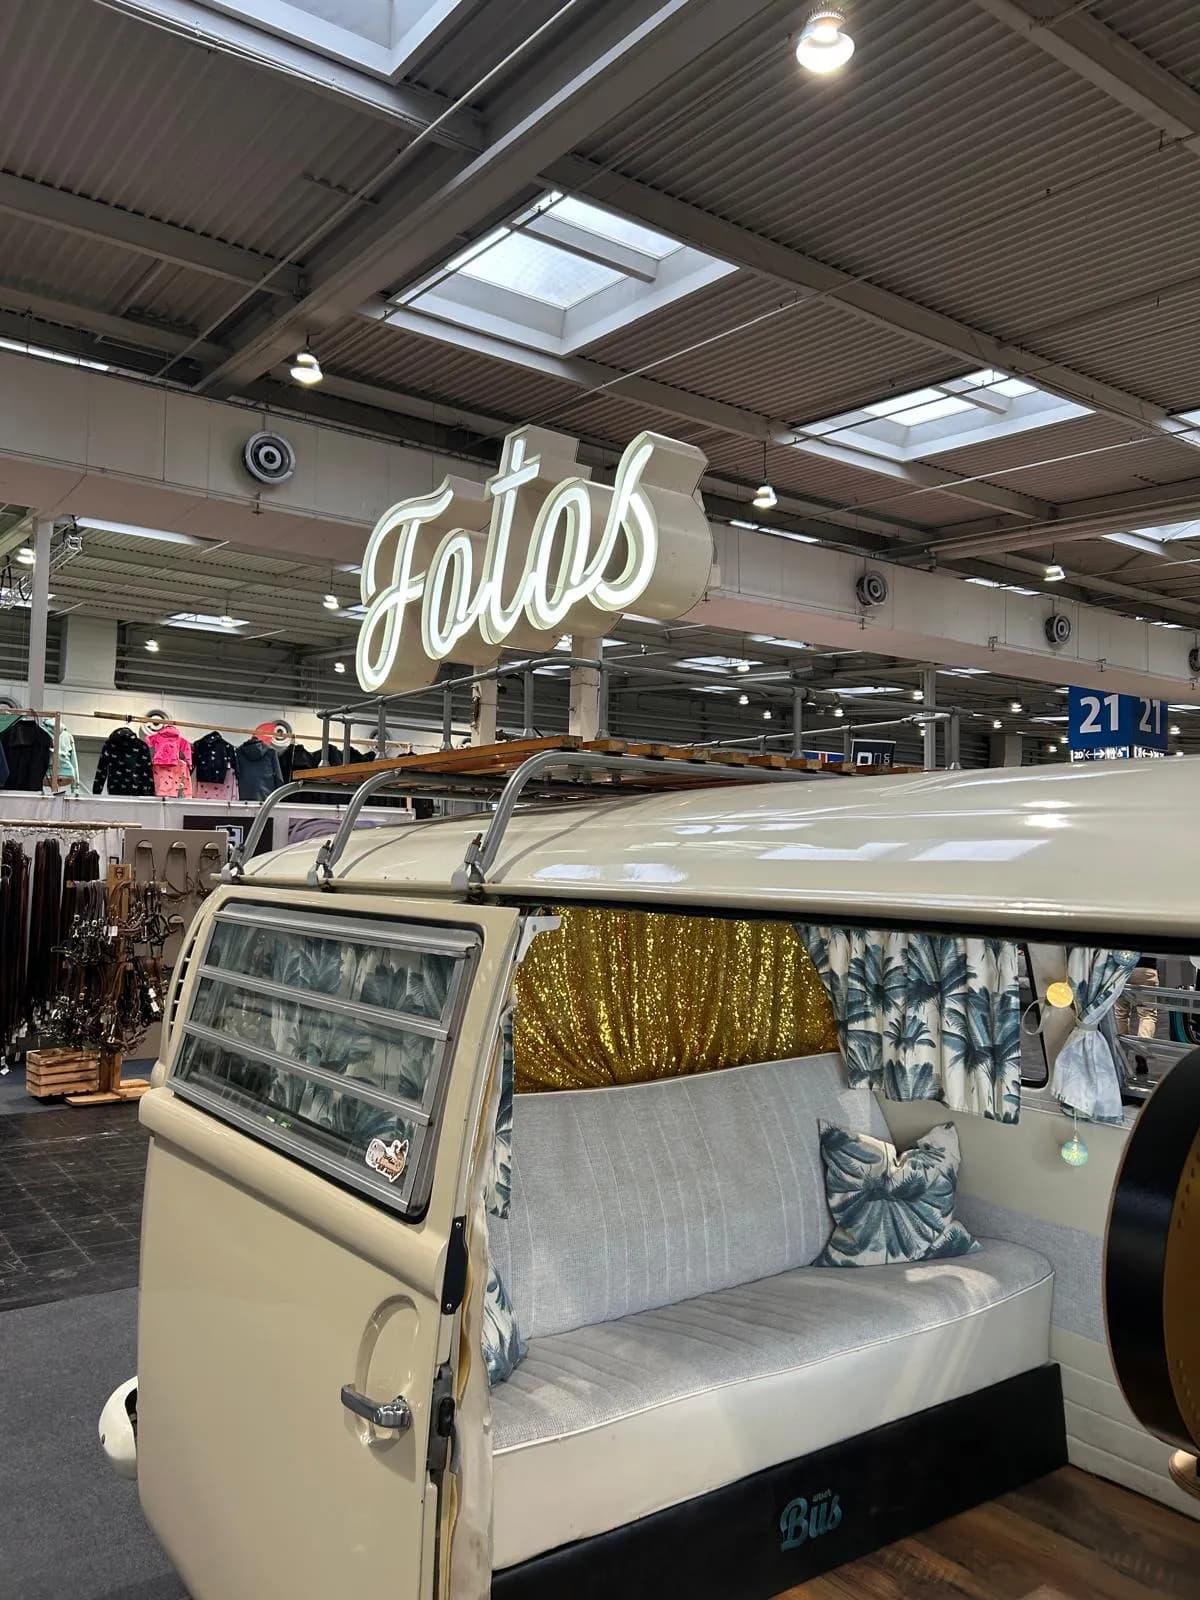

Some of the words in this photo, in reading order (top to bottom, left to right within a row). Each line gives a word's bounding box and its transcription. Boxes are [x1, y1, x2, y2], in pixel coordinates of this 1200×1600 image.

[356, 425, 660, 693] Fotos
[1079, 694, 1119, 734] 21
[1139, 698, 1161, 735] 21
